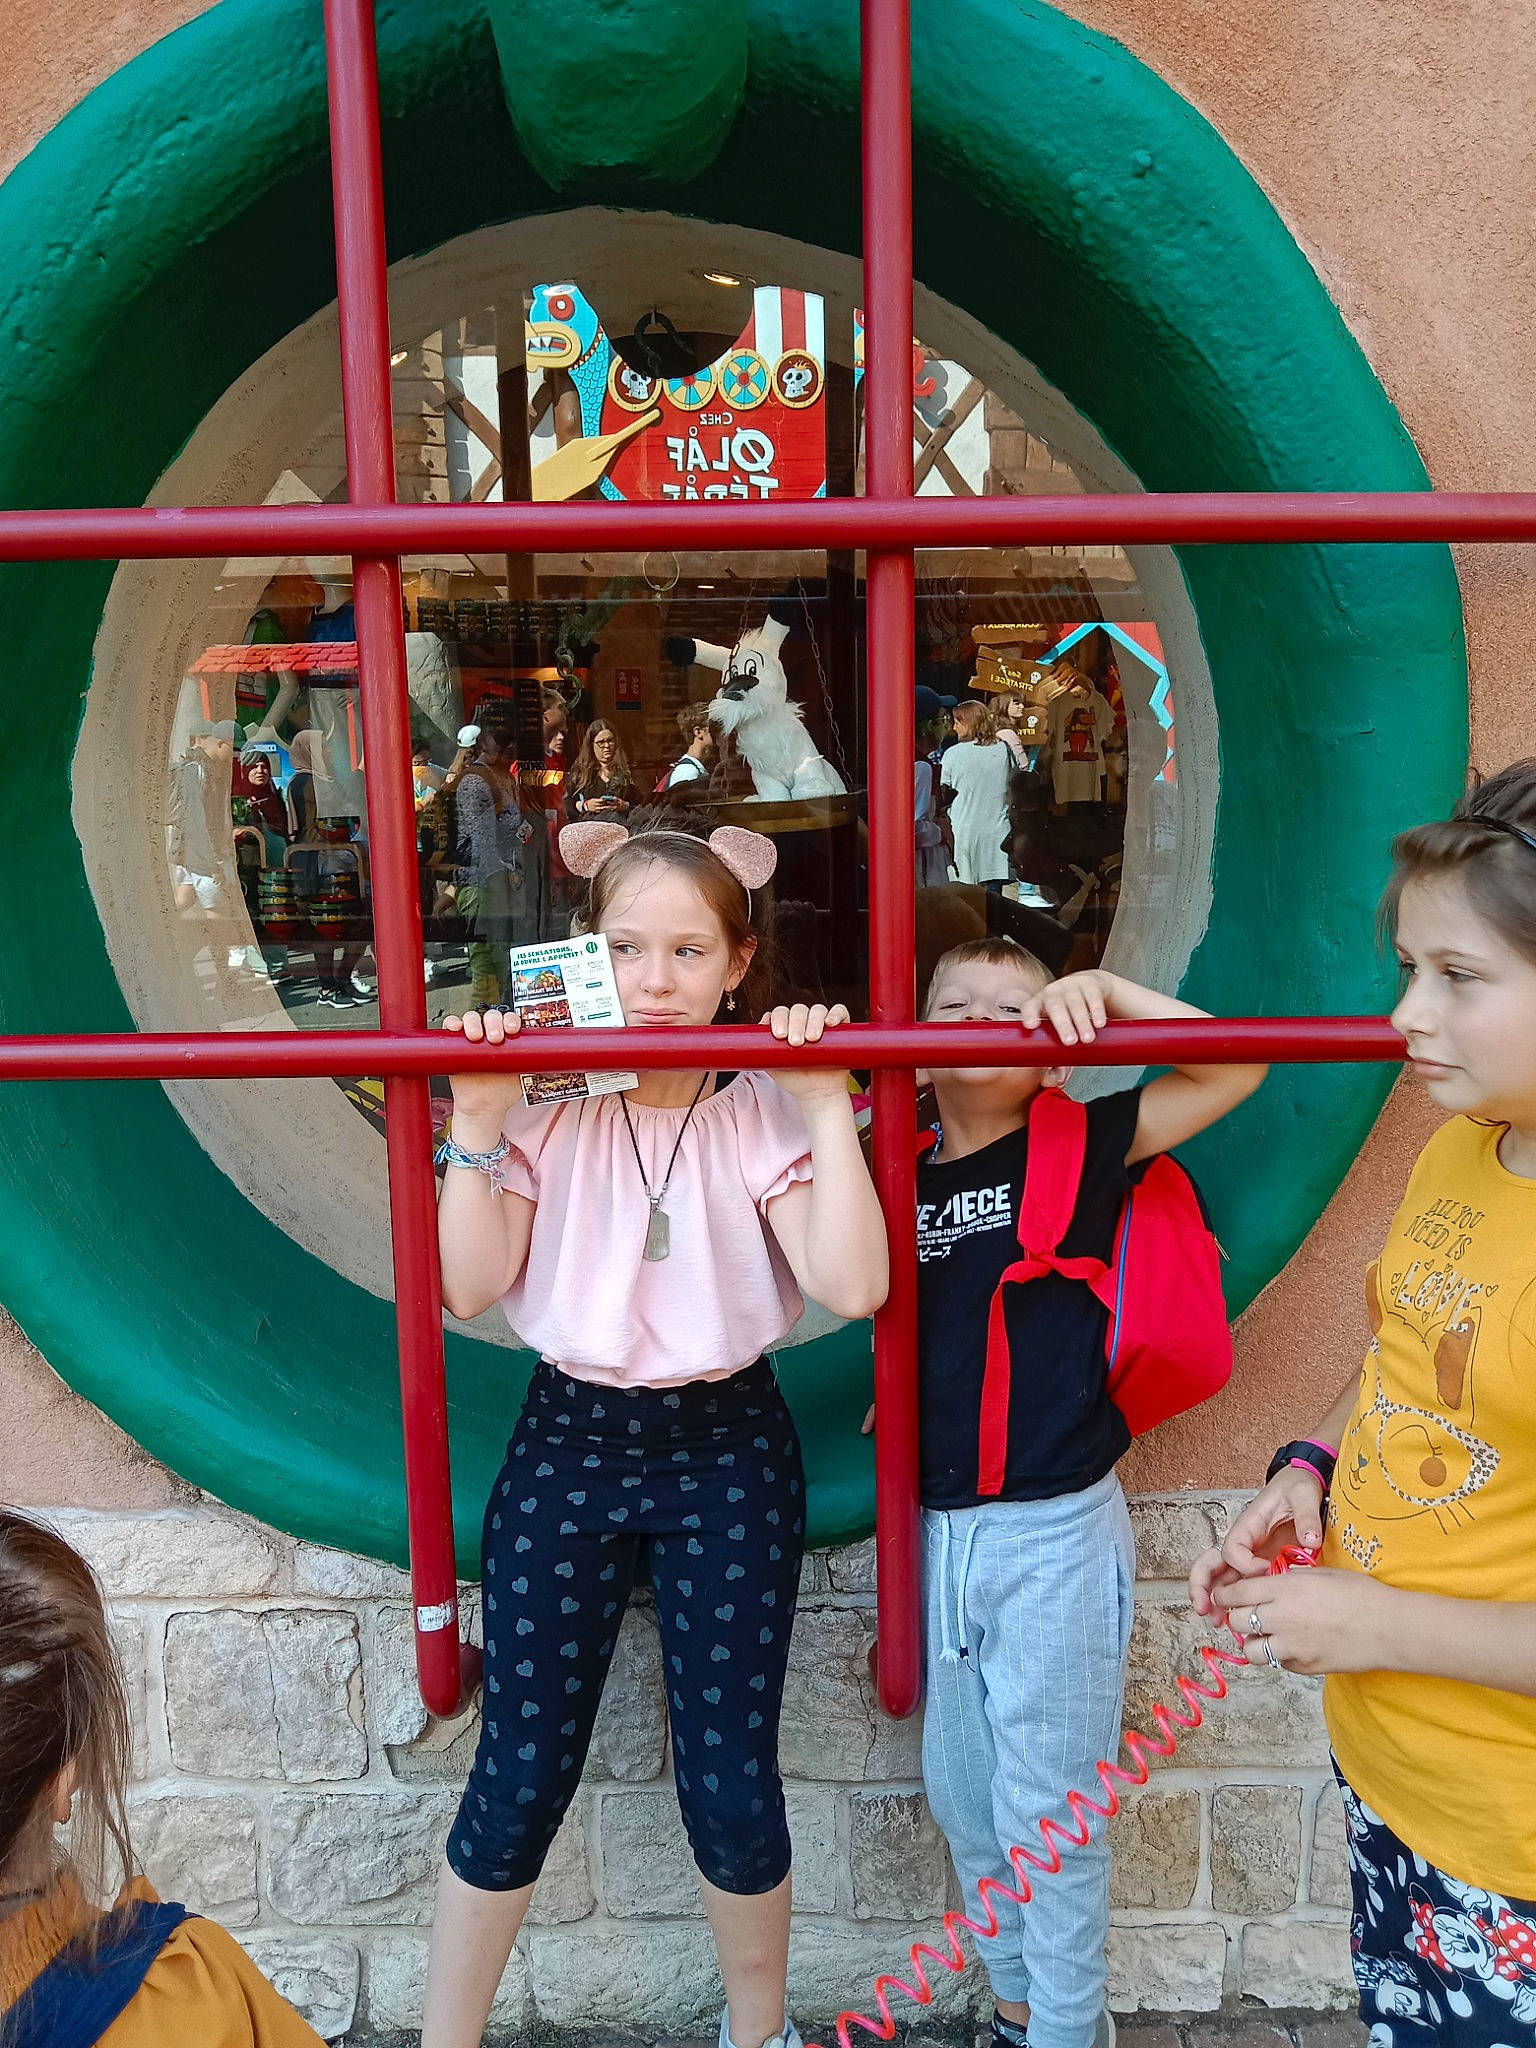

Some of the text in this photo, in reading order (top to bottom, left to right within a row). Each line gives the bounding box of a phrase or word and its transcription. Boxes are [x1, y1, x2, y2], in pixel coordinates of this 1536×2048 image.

[917, 1204, 937, 1230] E
[1425, 1198, 1486, 1229] ALL YOU
[1403, 1215, 1472, 1261] NEED IS
[917, 1245, 952, 1263] ピース
[1394, 1260, 1484, 1333] LOVE
